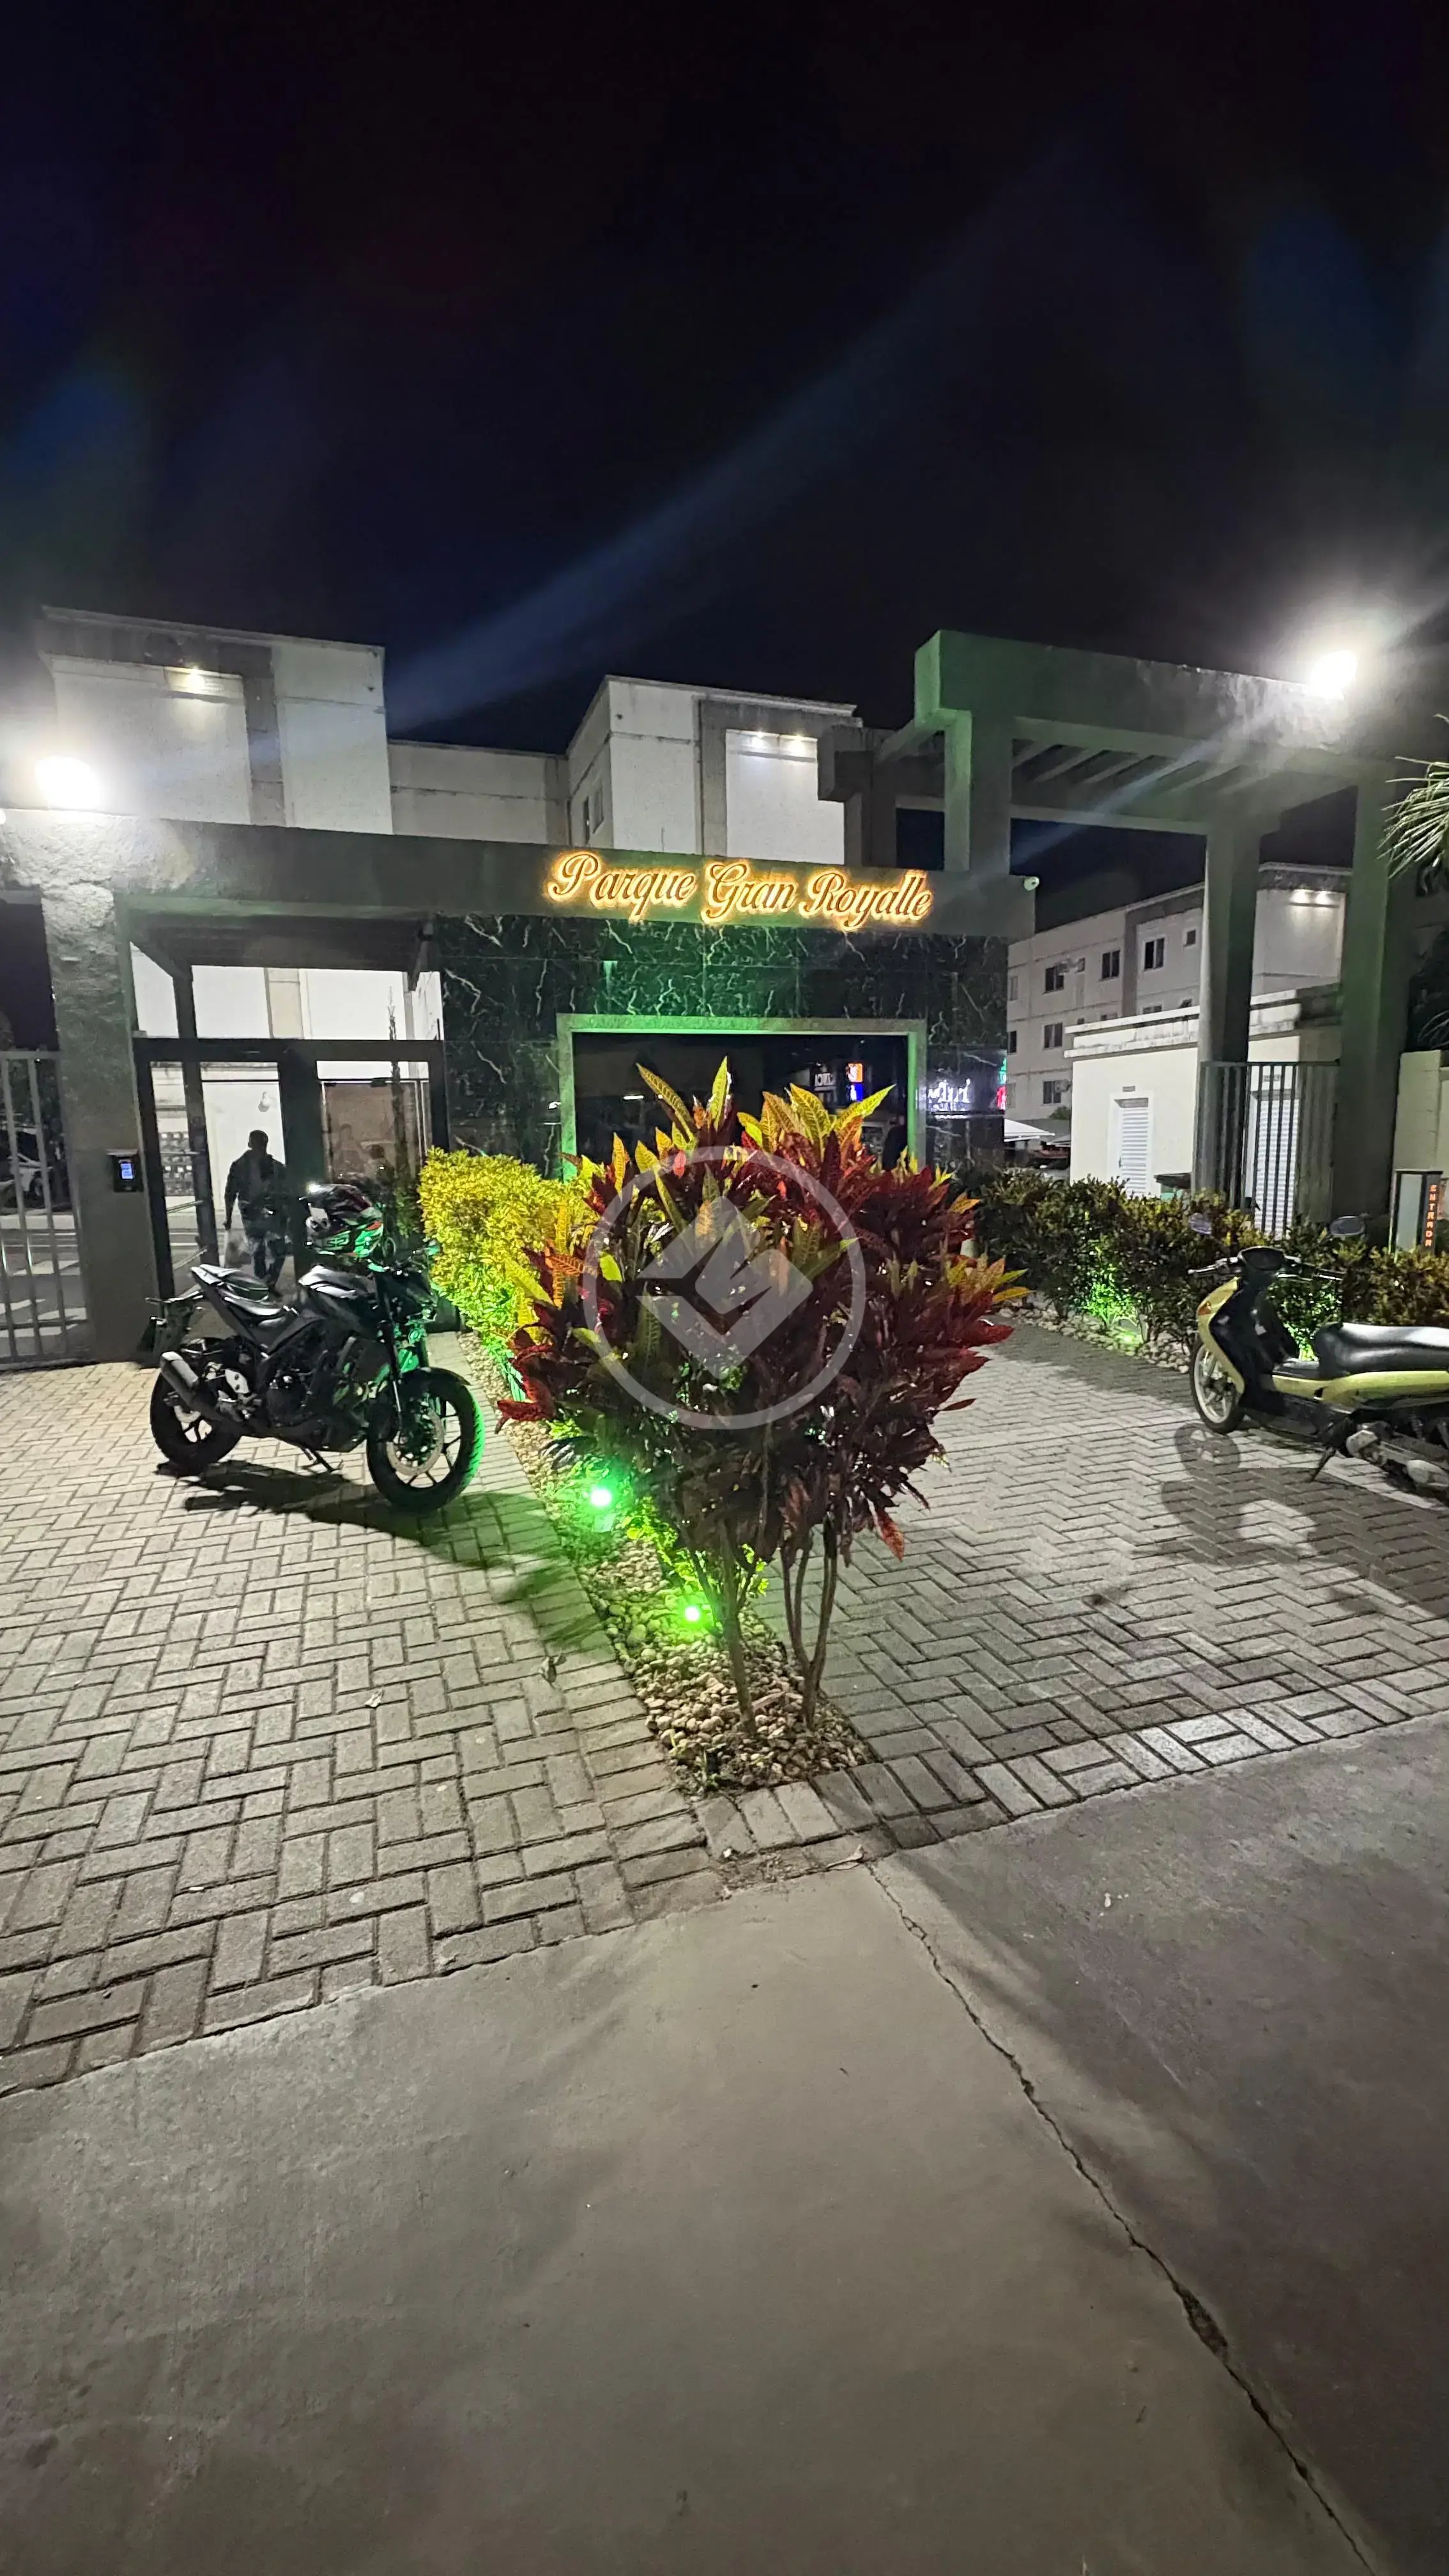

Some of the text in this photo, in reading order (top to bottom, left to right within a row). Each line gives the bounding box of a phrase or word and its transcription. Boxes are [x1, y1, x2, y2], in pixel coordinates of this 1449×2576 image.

[550, 852, 932, 928] Parque Gran Royalle
[1425, 1184, 1438, 1247] ENTRADA
